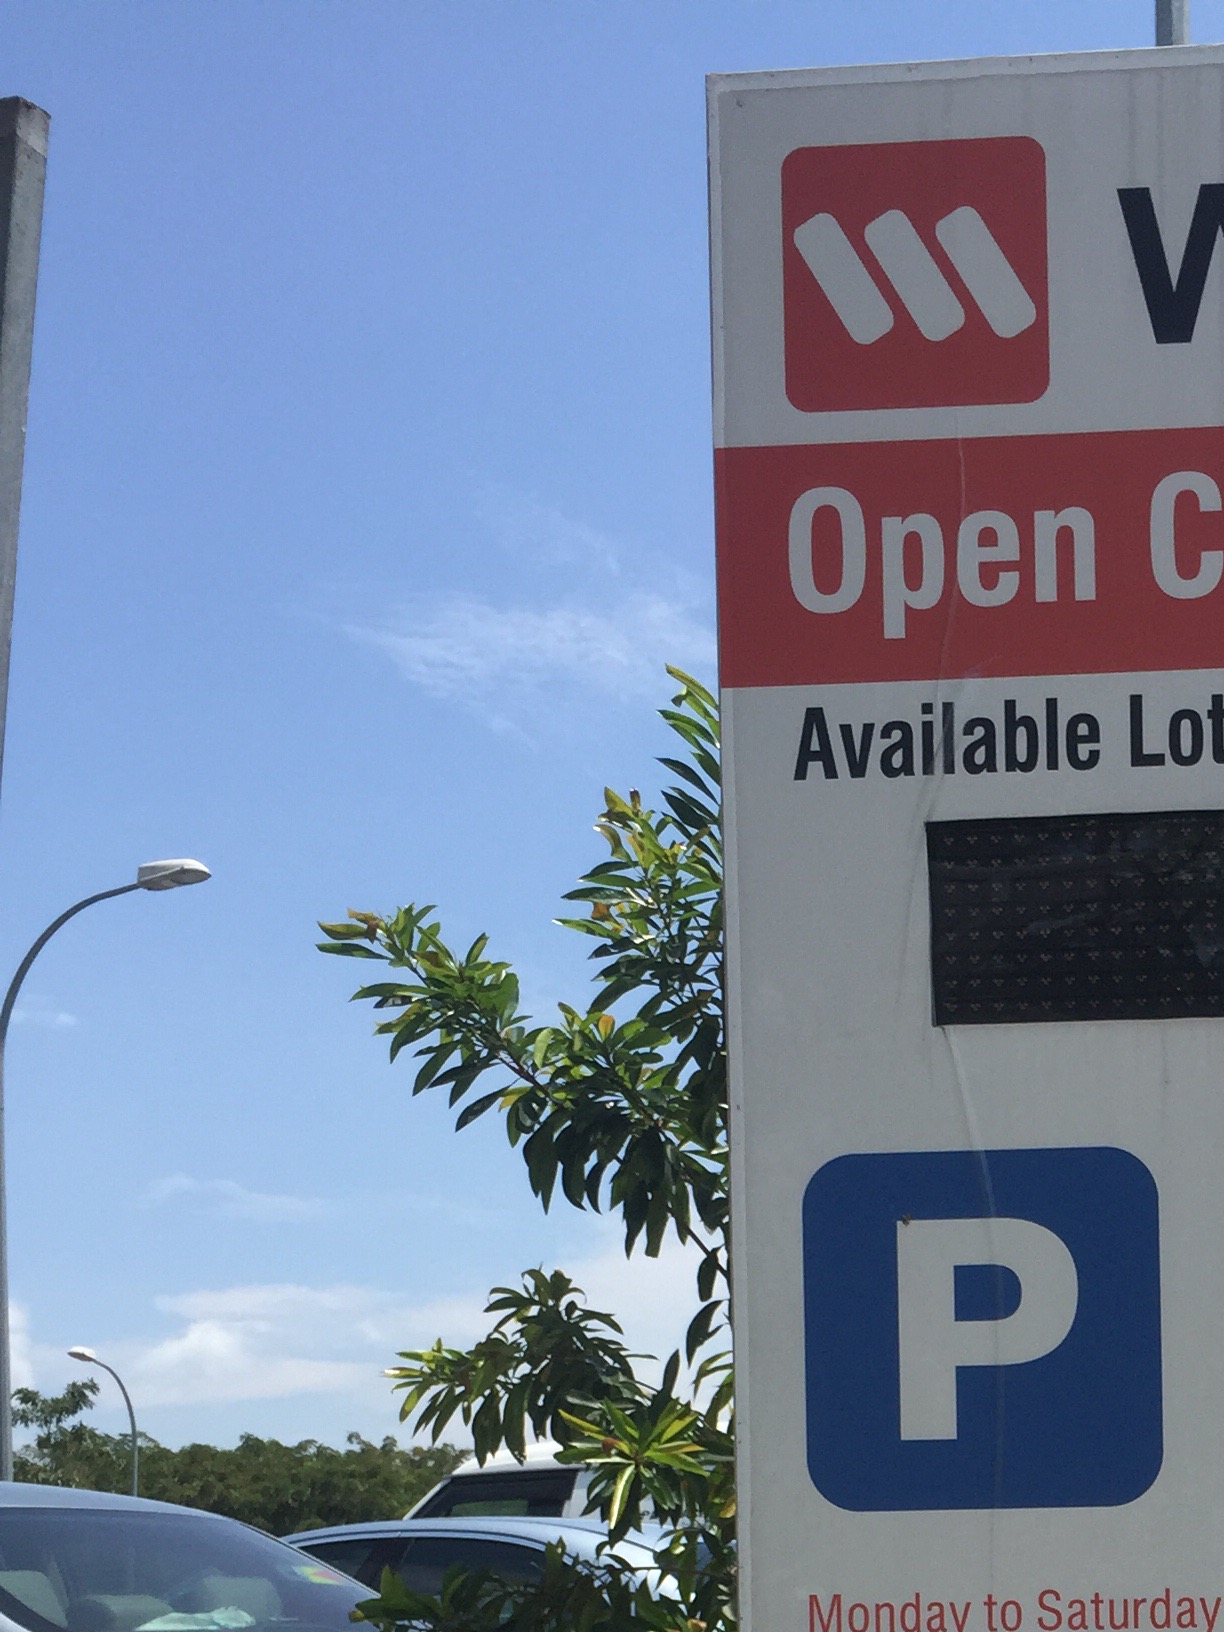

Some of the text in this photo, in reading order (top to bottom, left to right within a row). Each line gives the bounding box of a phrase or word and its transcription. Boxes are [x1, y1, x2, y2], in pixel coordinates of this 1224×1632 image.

[787, 485, 1097, 639] Open
[793, 697, 1102, 782] Available
[896, 1217, 1080, 1441] P
[984, 1595, 1023, 1632] to
